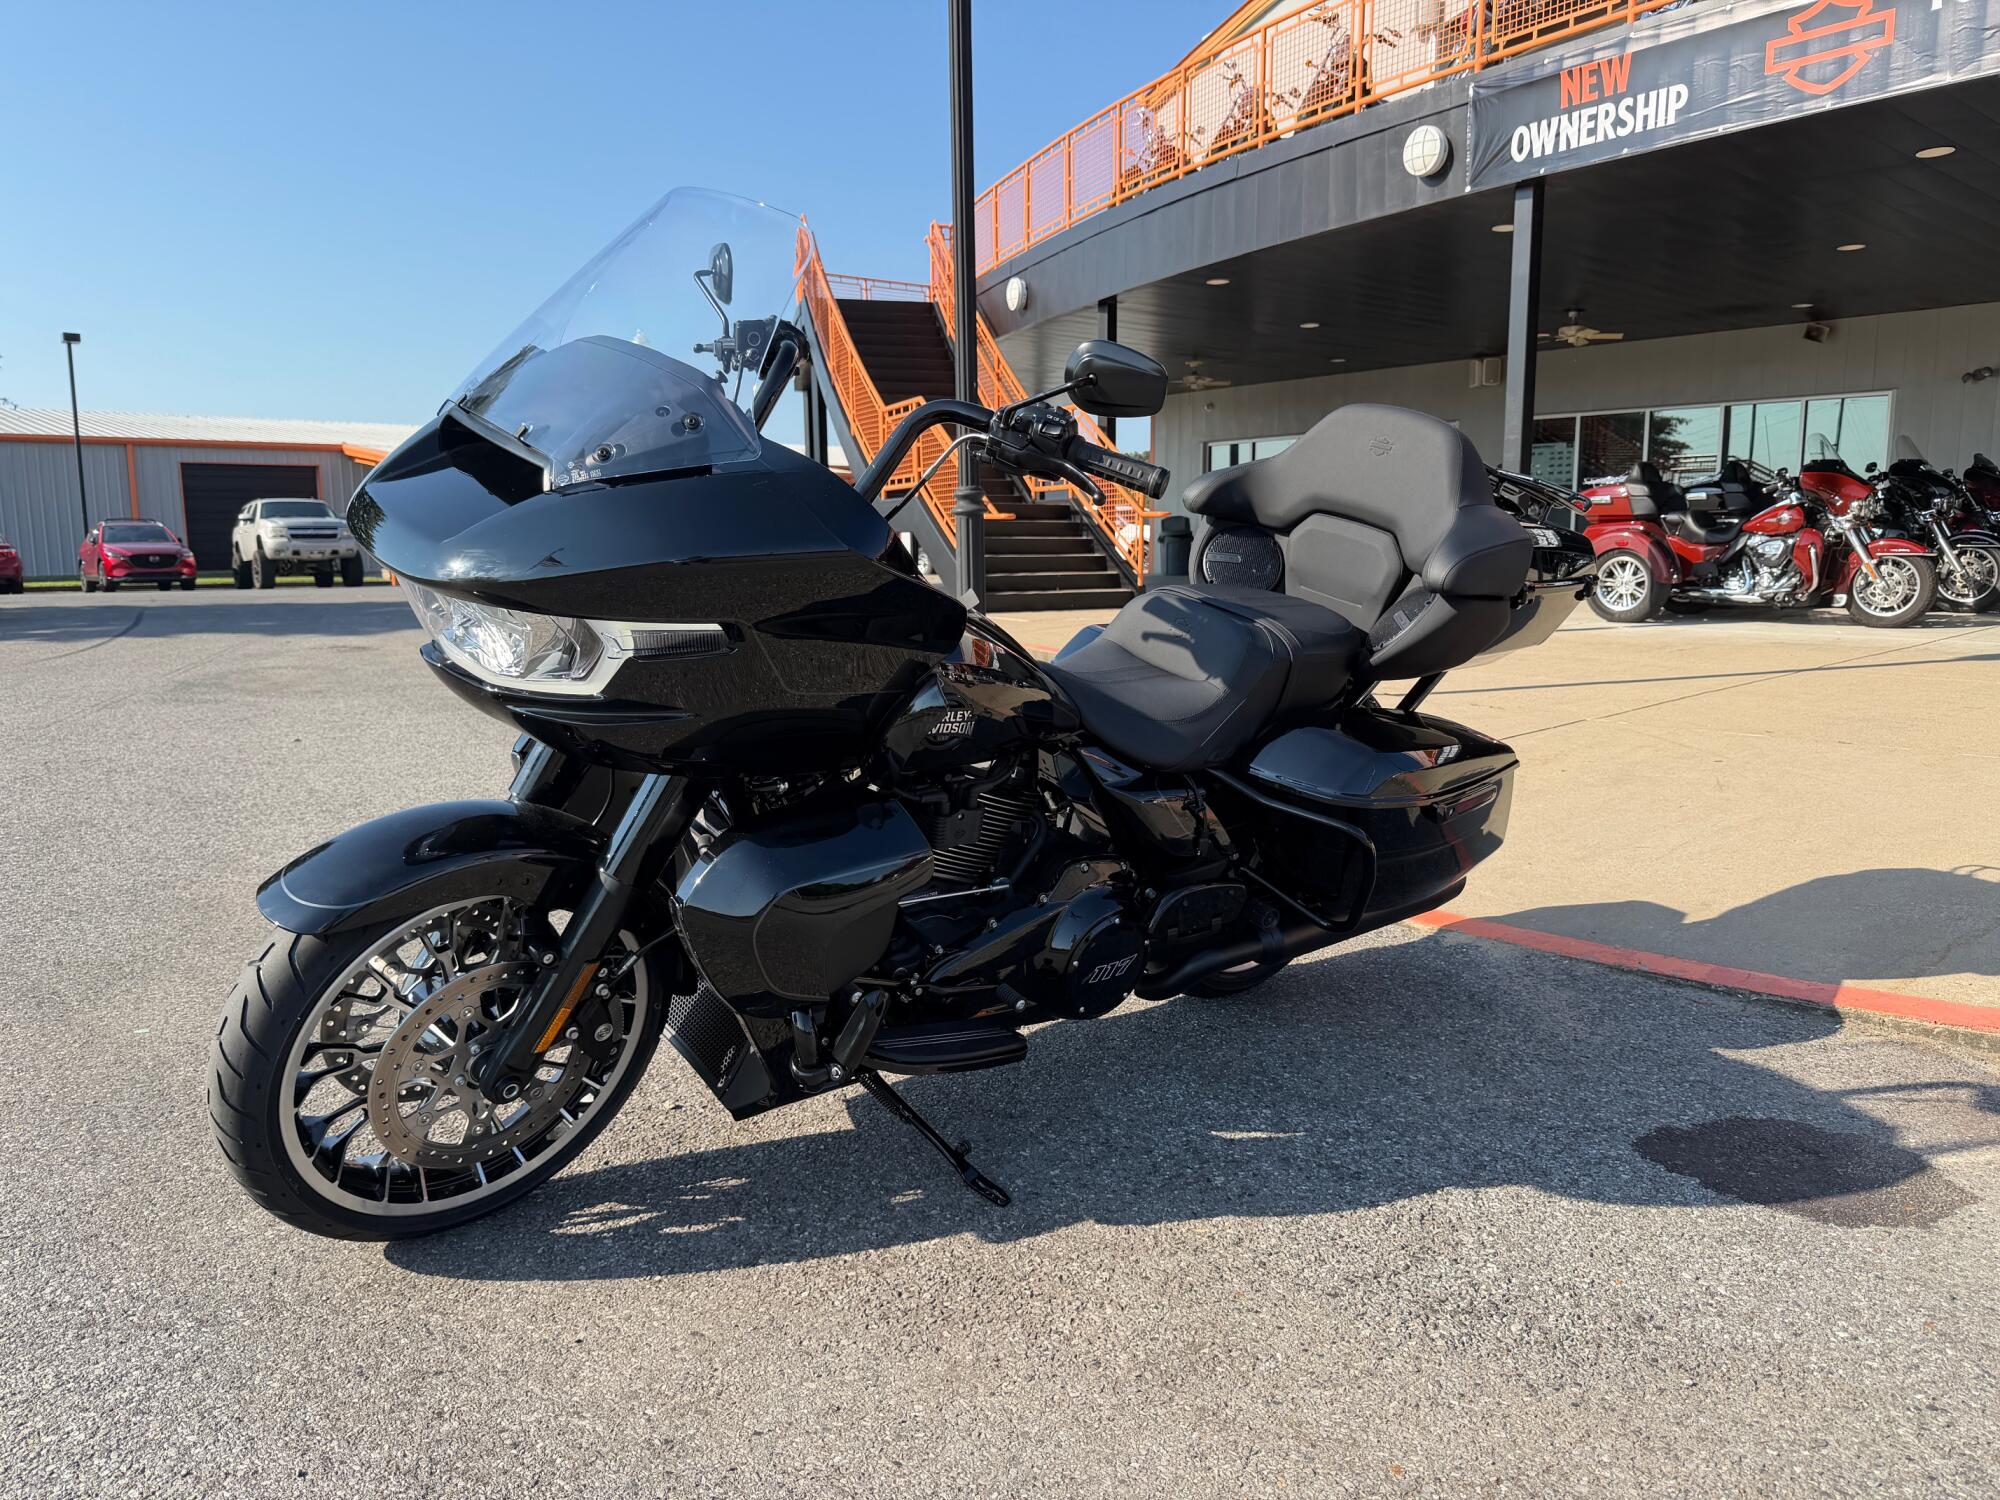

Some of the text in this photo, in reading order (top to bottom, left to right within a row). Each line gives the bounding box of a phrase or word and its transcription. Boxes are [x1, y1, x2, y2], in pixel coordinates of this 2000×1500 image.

[1560, 52, 1633, 109] NEW
[1510, 83, 1689, 163] OWNERSHIP
[928, 721, 975, 736] VIDSON
[1088, 953, 1138, 984] 117
